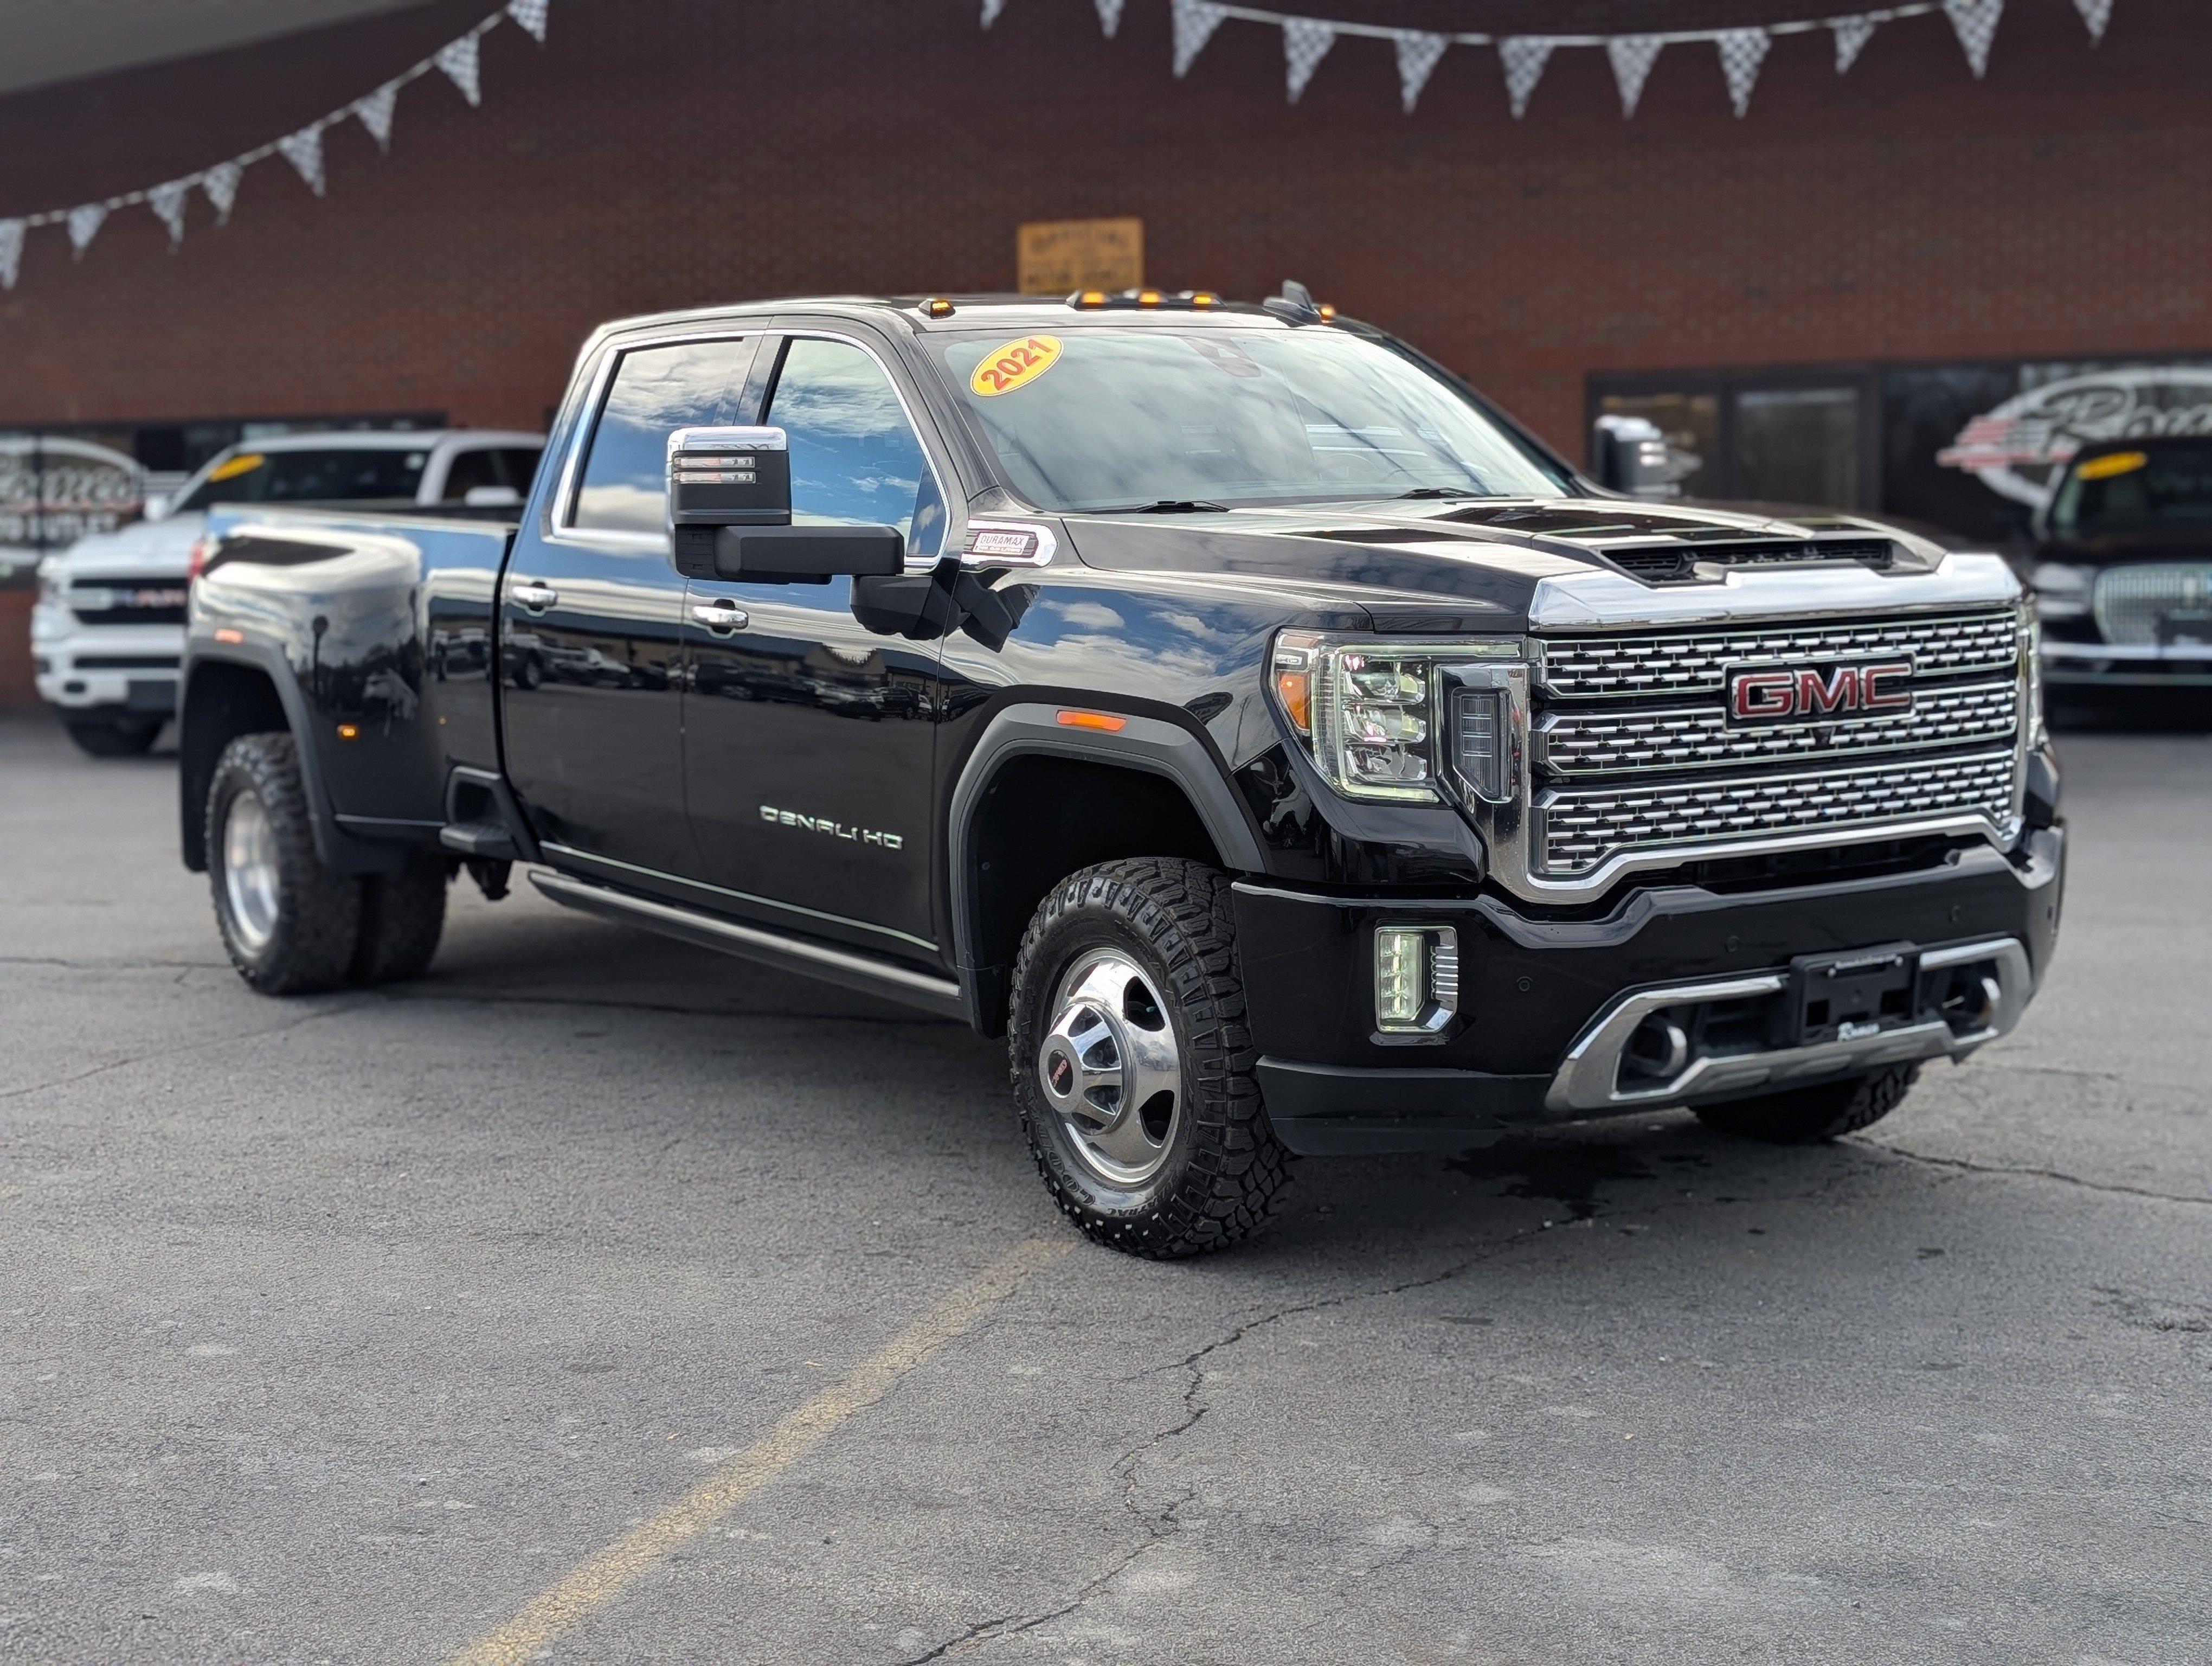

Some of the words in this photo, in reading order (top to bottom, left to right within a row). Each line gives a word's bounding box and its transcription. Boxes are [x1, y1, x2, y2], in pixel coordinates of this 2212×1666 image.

[981, 339, 1053, 391] 2021
[980, 535, 1024, 546] DURAMAX
[1732, 662, 1912, 720] GMC
[759, 805, 858, 841] DENALI
[863, 829, 903, 850] HD
